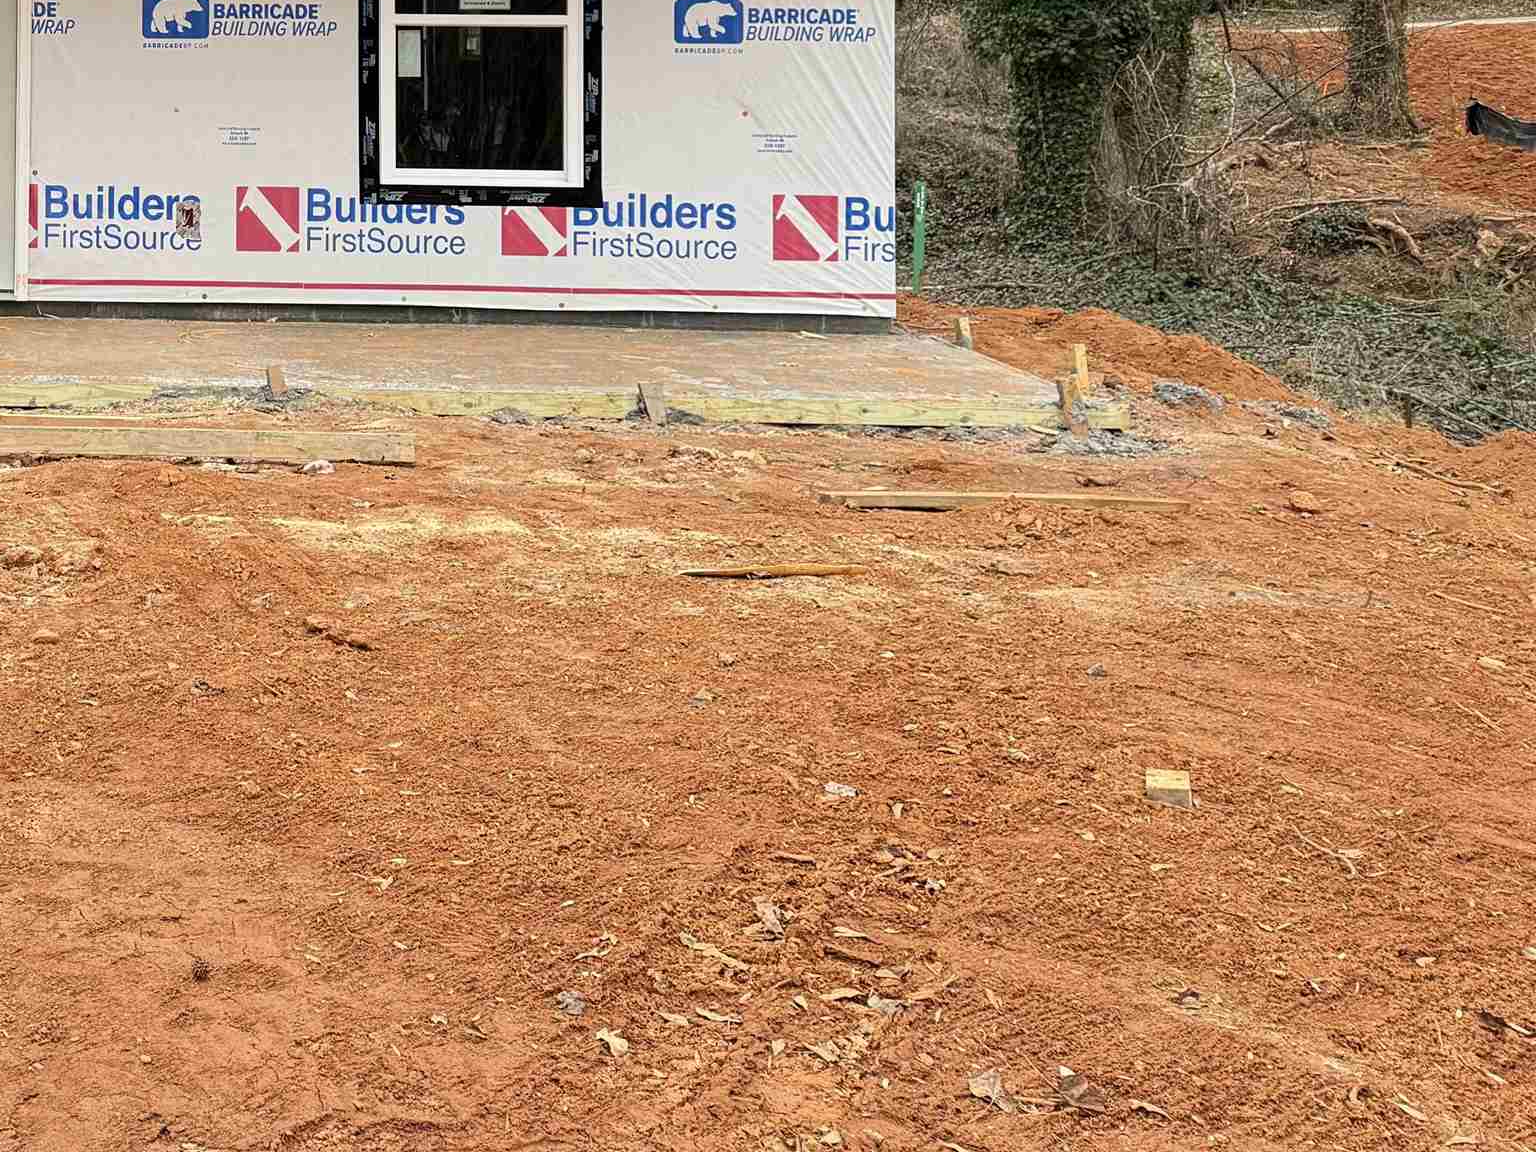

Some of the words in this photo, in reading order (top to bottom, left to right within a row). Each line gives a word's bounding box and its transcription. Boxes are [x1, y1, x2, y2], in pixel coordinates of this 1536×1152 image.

[32, 2, 56, 17] DE
[214, 4, 319, 19] BARRICADE
[748, 8, 856, 24] BARRICADE
[31, 19, 75, 34] WRAP
[212, 21, 287, 36] BUILDING
[292, 22, 337, 37] WRAP
[746, 26, 824, 41] BUILDING
[829, 27, 876, 43] WRAP
[45, 185, 200, 220] Builder
[573, 193, 736, 229] Builders
[307, 227, 465, 254] FirstSource
[573, 231, 736, 259] FirstSource
